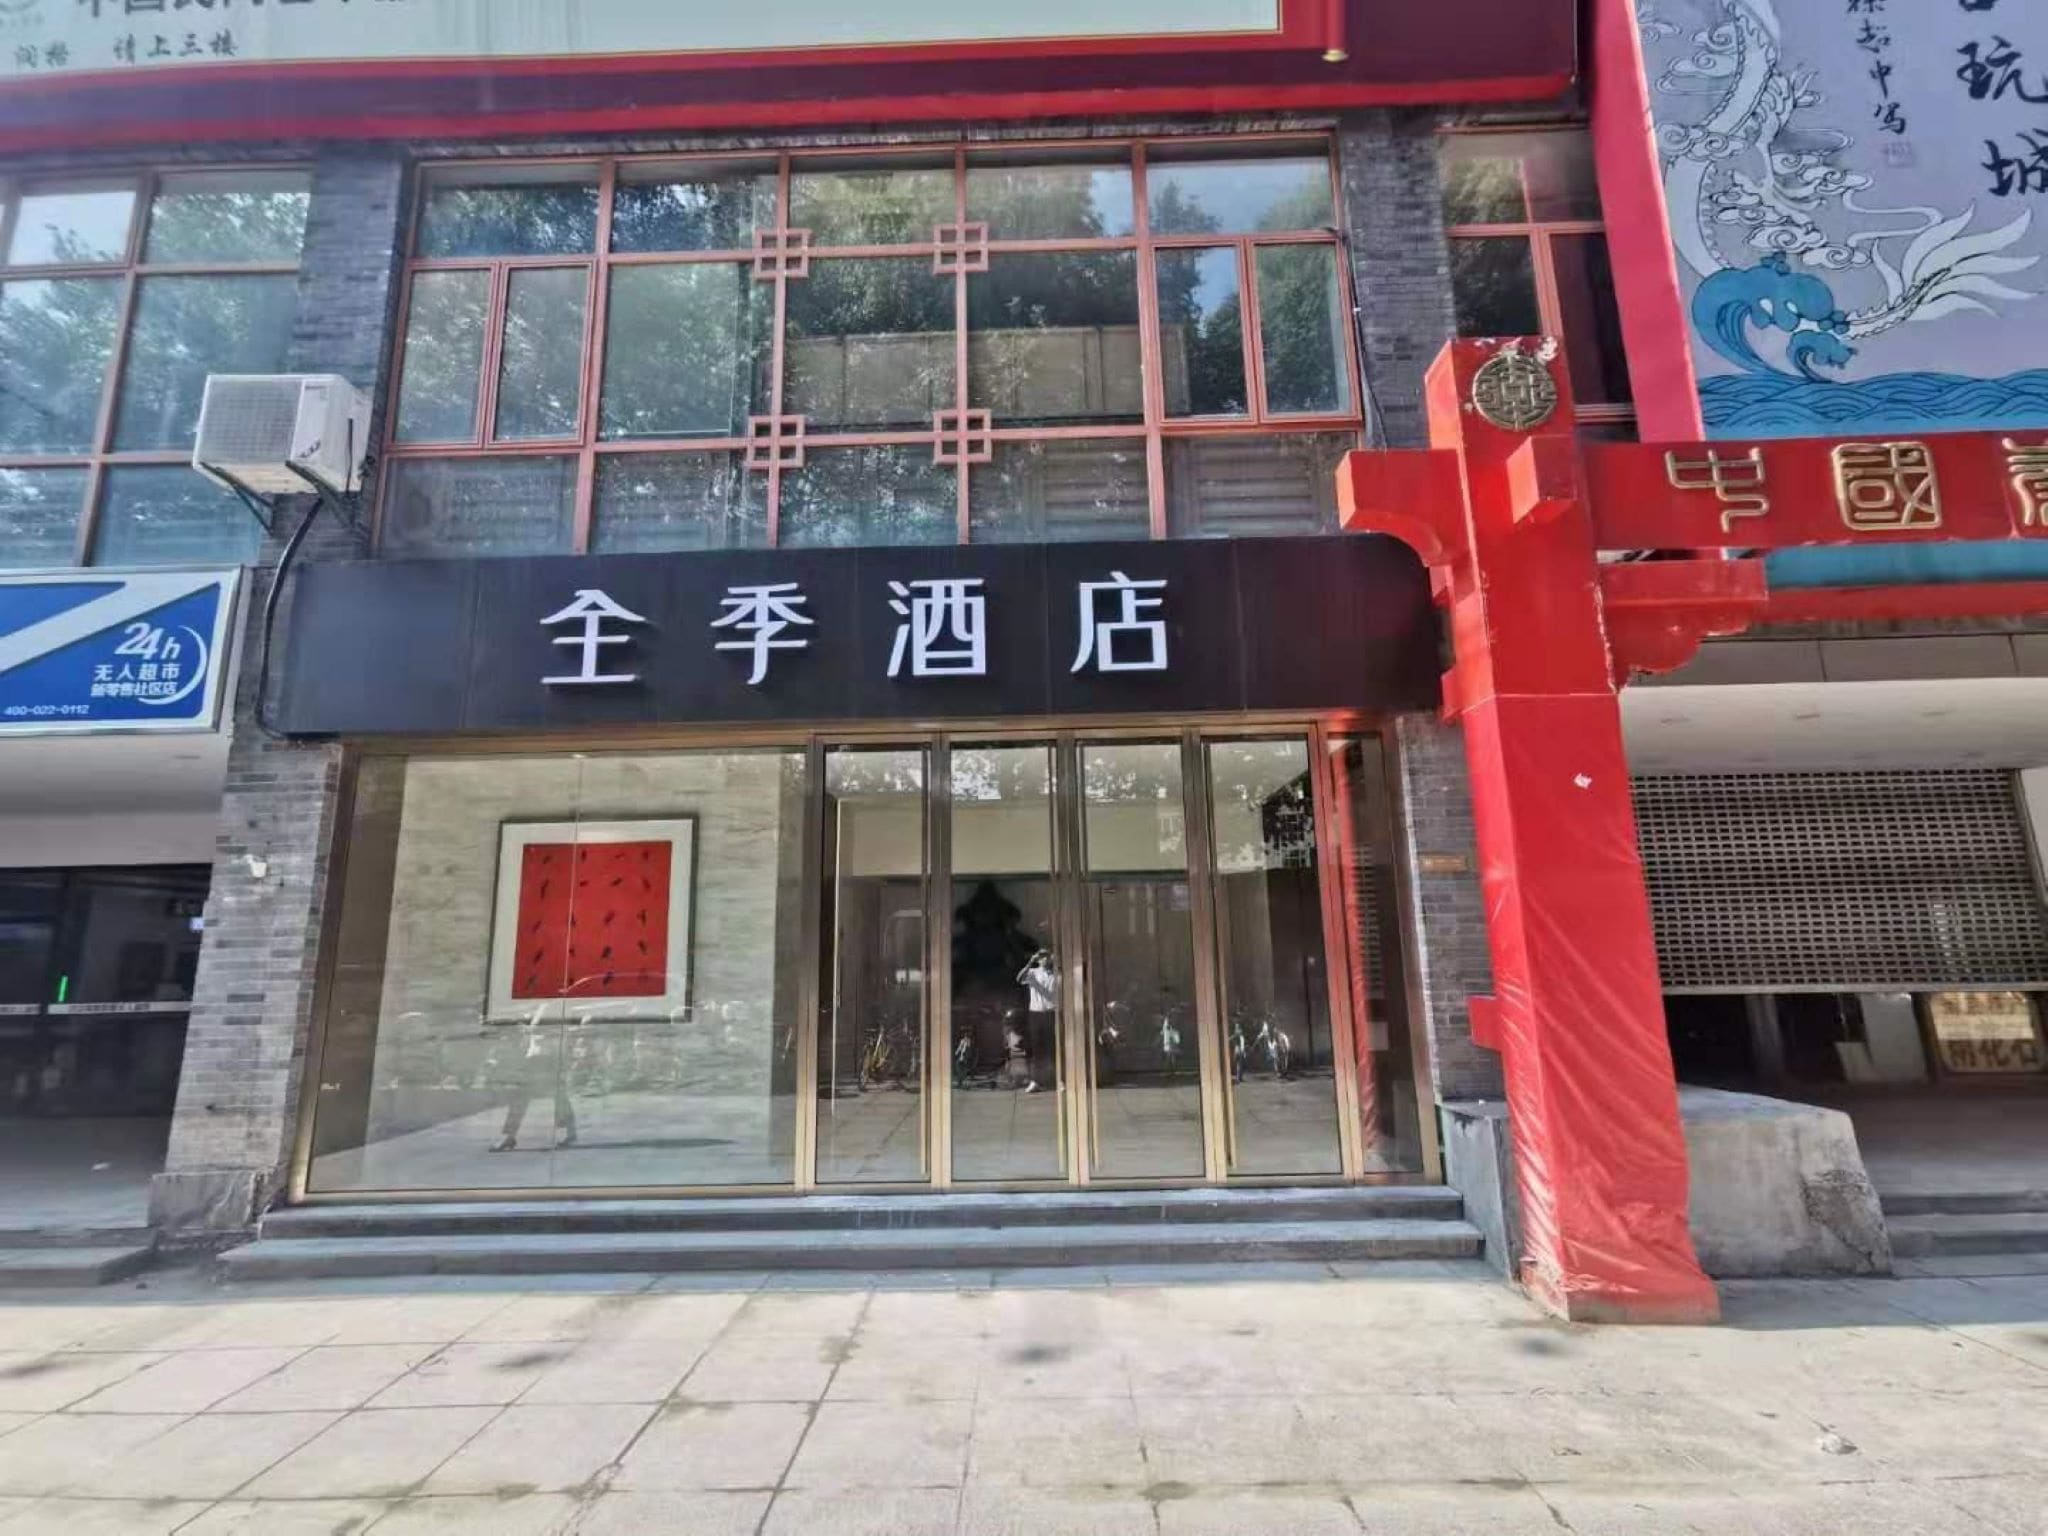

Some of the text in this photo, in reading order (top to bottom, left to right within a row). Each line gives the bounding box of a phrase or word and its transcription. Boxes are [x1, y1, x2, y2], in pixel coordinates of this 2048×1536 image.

[114, 622, 182, 660] 24h
[540, 571, 1168, 685] 全季酒店
[94, 663, 181, 681] 无人超市
